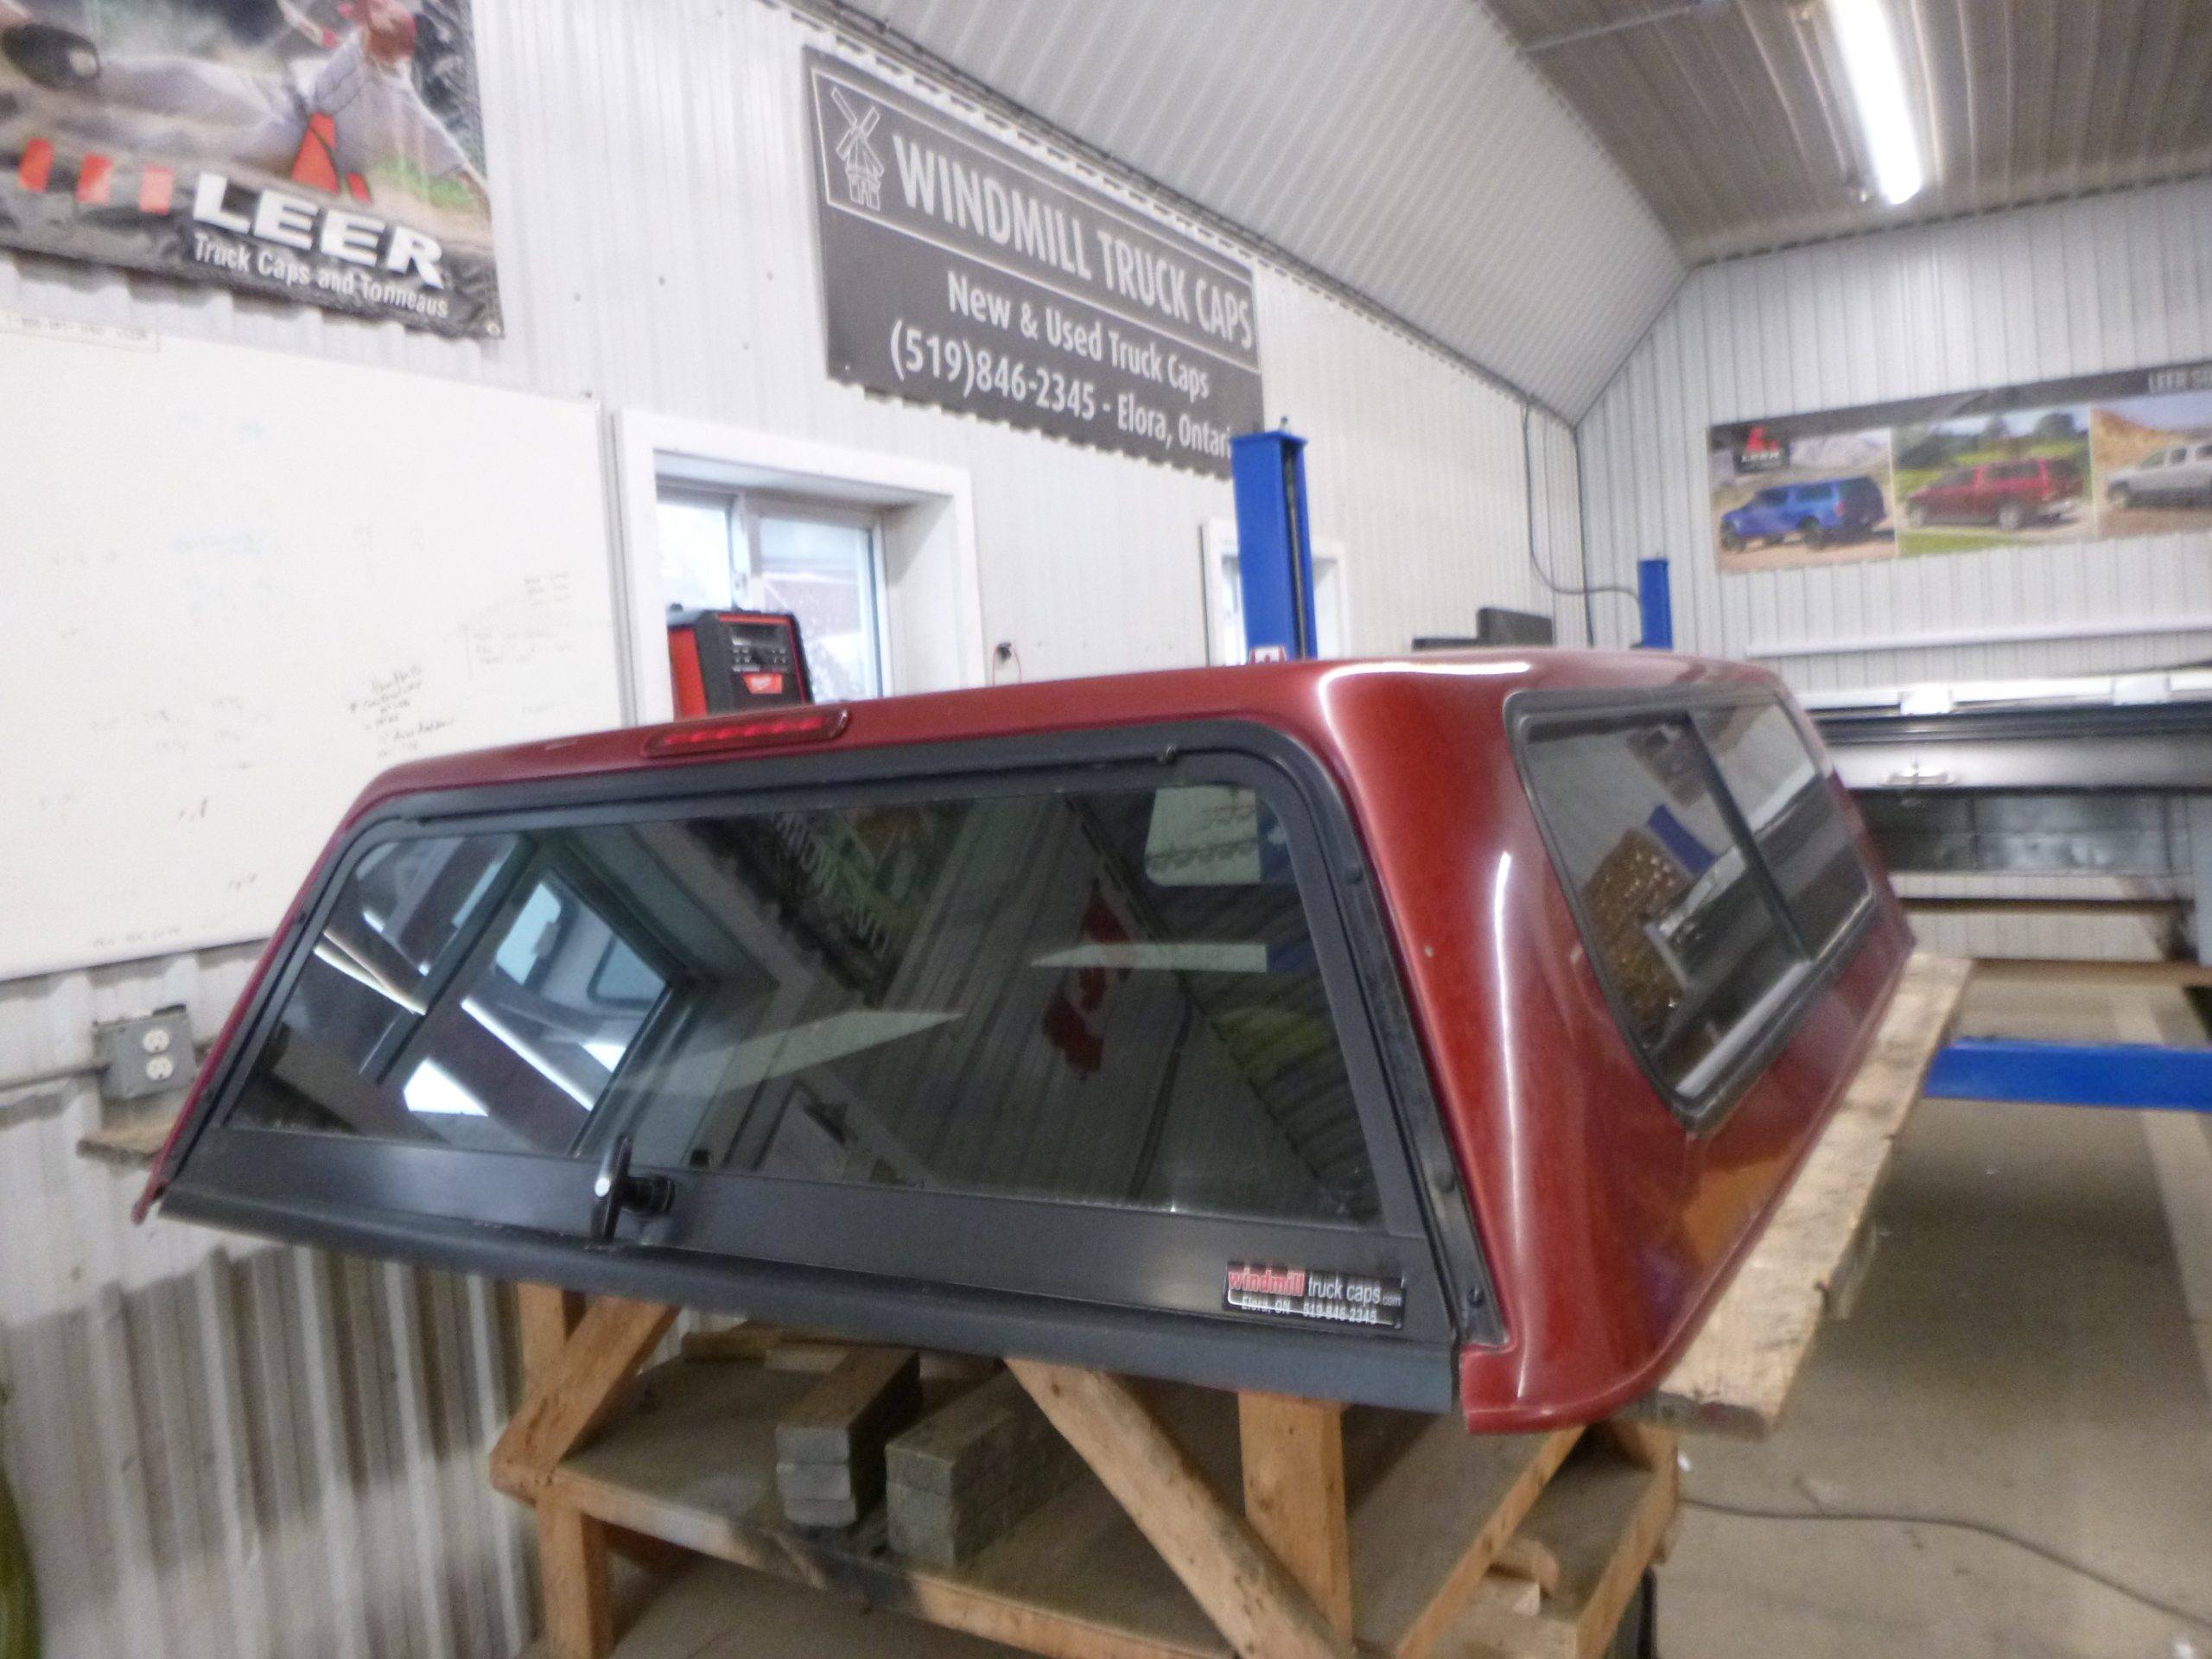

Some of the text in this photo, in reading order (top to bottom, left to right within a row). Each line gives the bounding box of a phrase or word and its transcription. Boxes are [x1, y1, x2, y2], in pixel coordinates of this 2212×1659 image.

[193, 172, 444, 290] LEER
[194, 232, 251, 272] Truck
[257, 251, 310, 288] Caps
[317, 267, 355, 296] and
[893, 134, 1252, 349] WINDMILL TRUCK CAPS
[891, 319, 1096, 421] (519)846-2345
[1118, 392, 1173, 450] Elora,
[1179, 413, 1231, 460] Ontari
[948, 270, 1209, 404] New & Used Truck Caps
[1308, 1273, 1342, 1300] truck
[1345, 1283, 1381, 1306] caps
